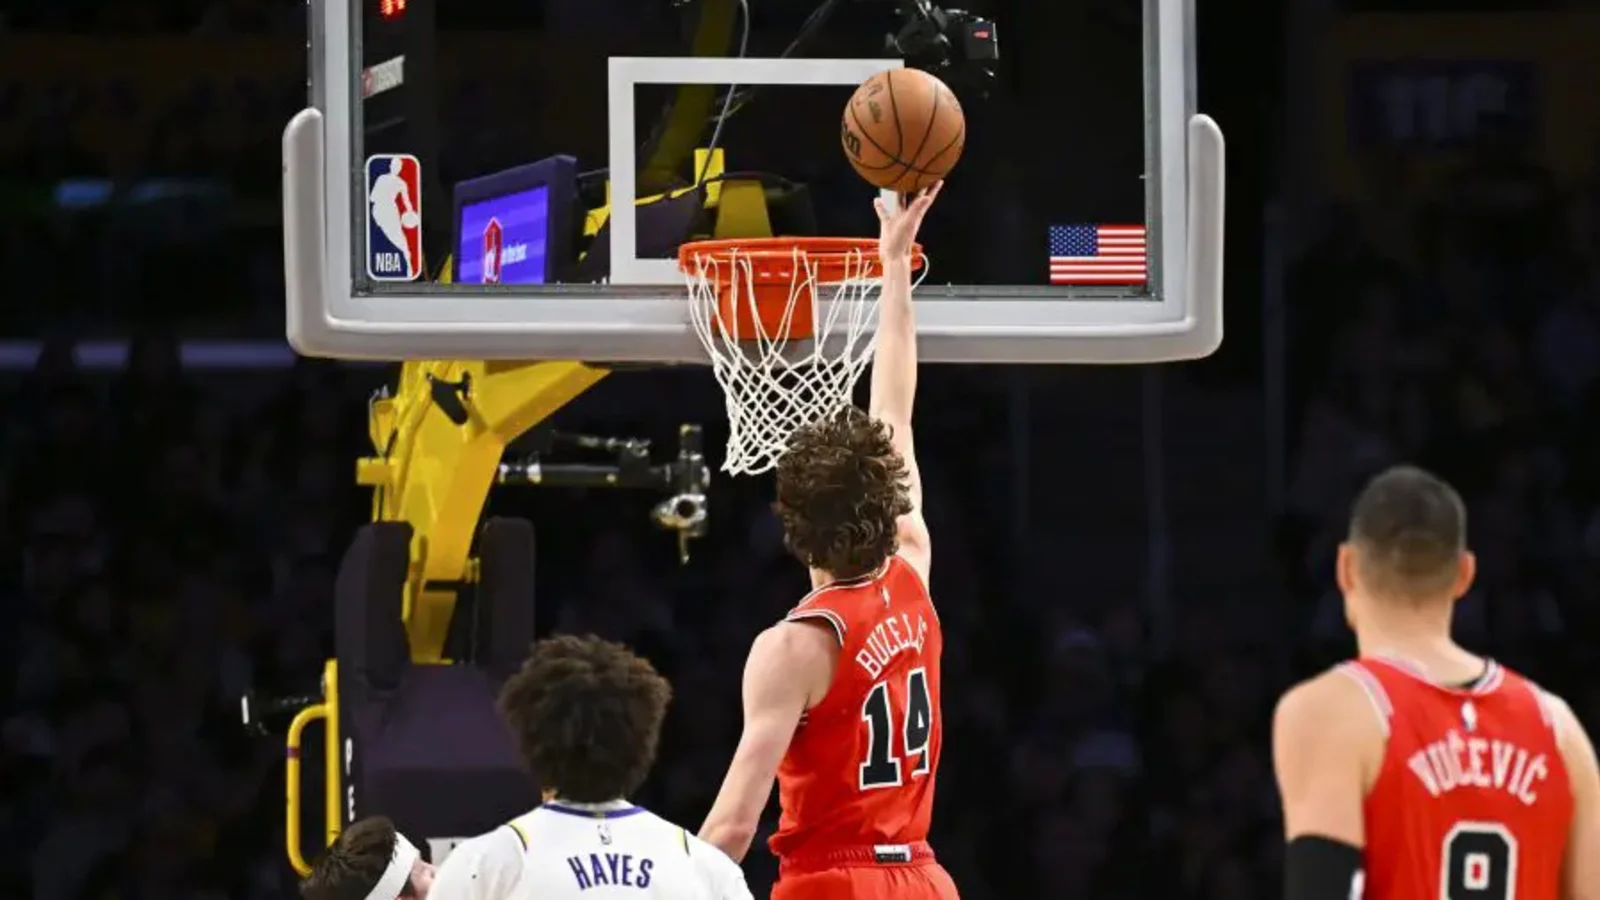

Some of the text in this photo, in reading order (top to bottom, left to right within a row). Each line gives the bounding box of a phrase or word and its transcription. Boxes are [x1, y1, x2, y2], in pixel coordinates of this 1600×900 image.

[376, 252, 401, 272] NBA
[859, 667, 932, 790] 14
[567, 852, 654, 891] HAYES
